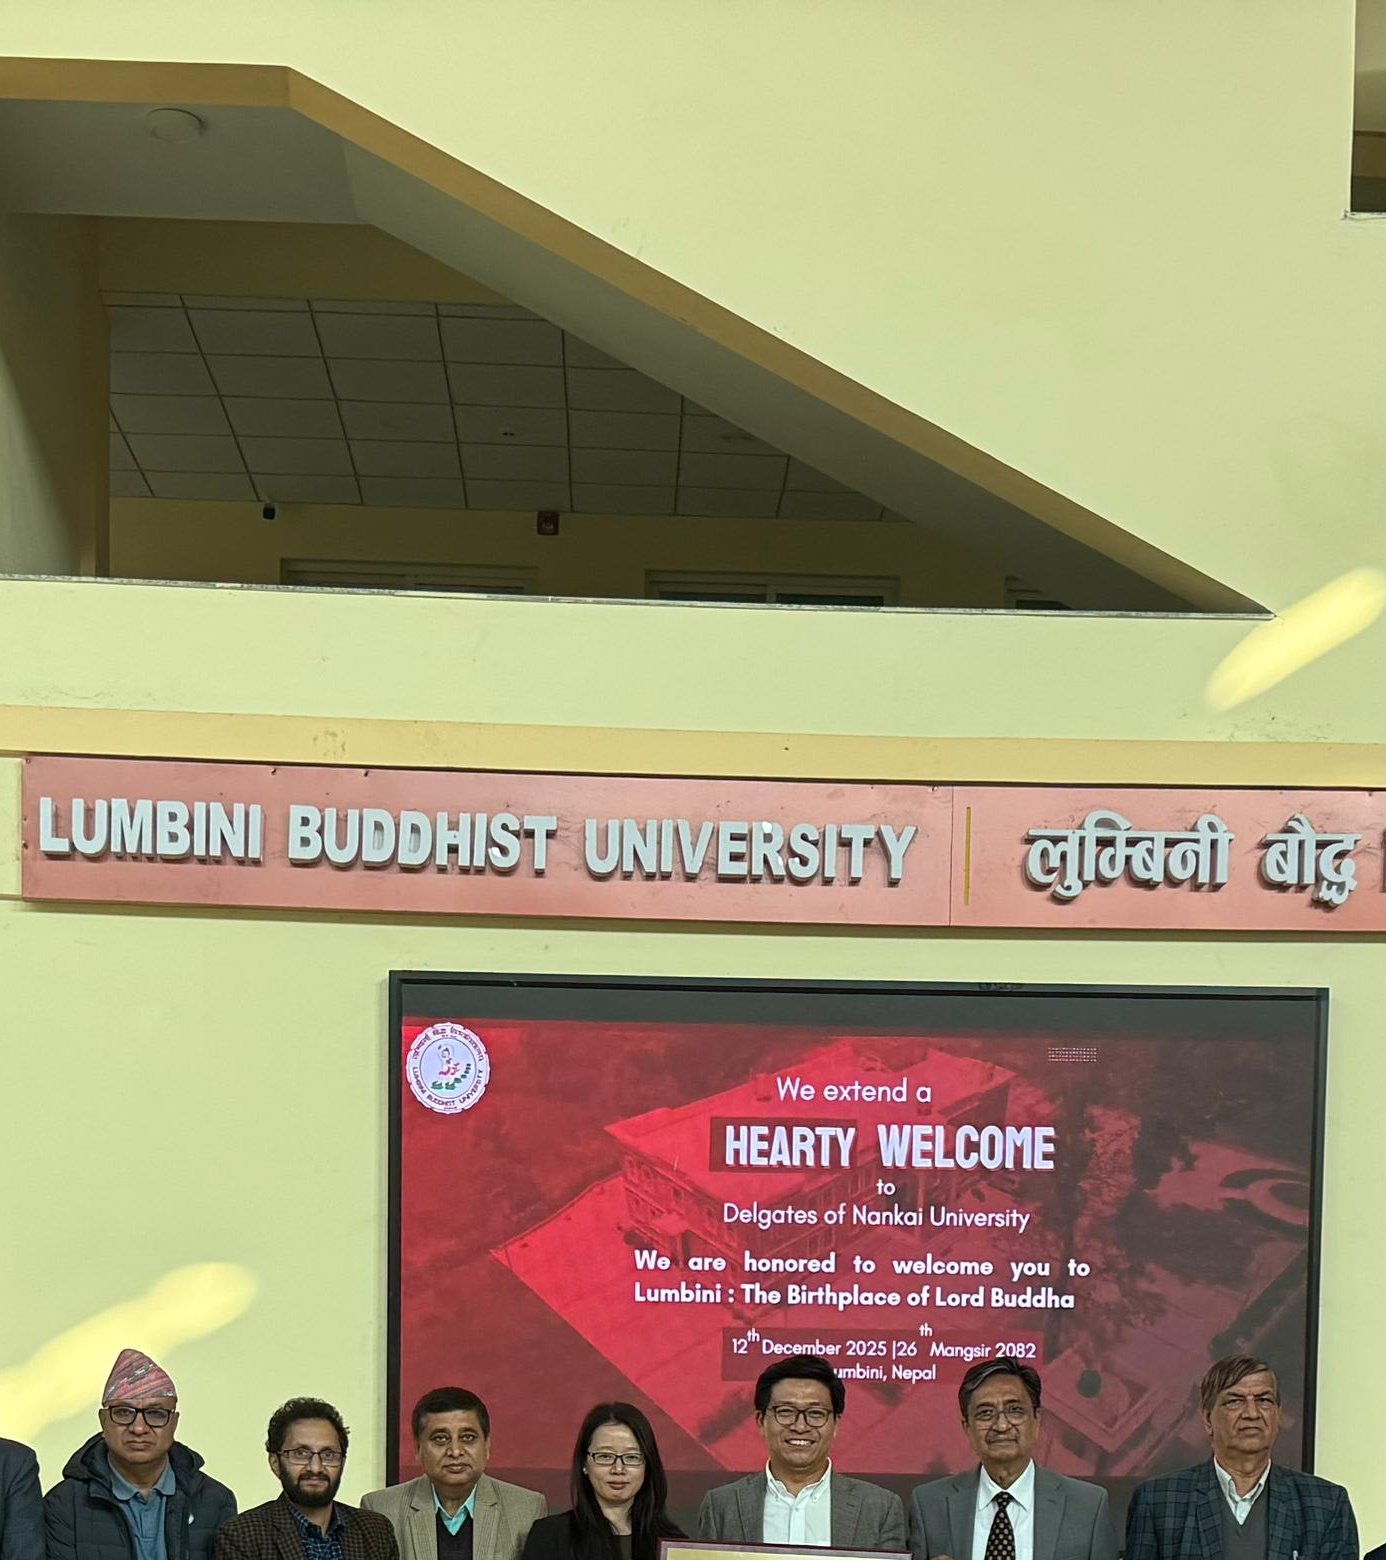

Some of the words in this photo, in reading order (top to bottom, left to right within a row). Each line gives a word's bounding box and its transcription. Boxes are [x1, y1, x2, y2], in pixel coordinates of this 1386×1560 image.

[39, 797, 262, 862] LUMBINI
[288, 805, 557, 875] BUDDHIST
[584, 819, 917, 884] UNIVERSITY
[1025, 810, 1233, 900] लुम्बिनी
[776, 1076, 816, 1101] We
[823, 1077, 907, 1102] extend
[916, 1086, 932, 1103] a
[725, 1125, 856, 1168] HEARTY
[877, 1124, 1056, 1170] WELCOME
[876, 1178, 896, 1196] to
[723, 1201, 818, 1230] Delgates
[823, 1202, 847, 1225] of
[852, 1203, 924, 1227] Nankai
[930, 1206, 1031, 1234] University
[634, 1249, 671, 1271] We
[688, 1256, 727, 1272] are
[744, 1250, 837, 1273] honored
[853, 1255, 876, 1274] to
[893, 1253, 994, 1276] welcome
[1010, 1261, 1051, 1282] you
[1067, 1259, 1091, 1277] to
[634, 1281, 722, 1304] Lumbini
[727, 1288, 735, 1303] :
[740, 1282, 782, 1305] The
[787, 1283, 901, 1312] Birthplace
[906, 1285, 930, 1307] of
[935, 1286, 985, 1308] Lord
[991, 1287, 1076, 1309] Buddha
[762, 1339, 842, 1356] December
[846, 1340, 887, 1357] 2025
[930, 1341, 992, 1362] Mangsir
[995, 1342, 1037, 1359] 2082
[834, 1363, 888, 1382] umbini,
[892, 1363, 937, 1385] Nepal
